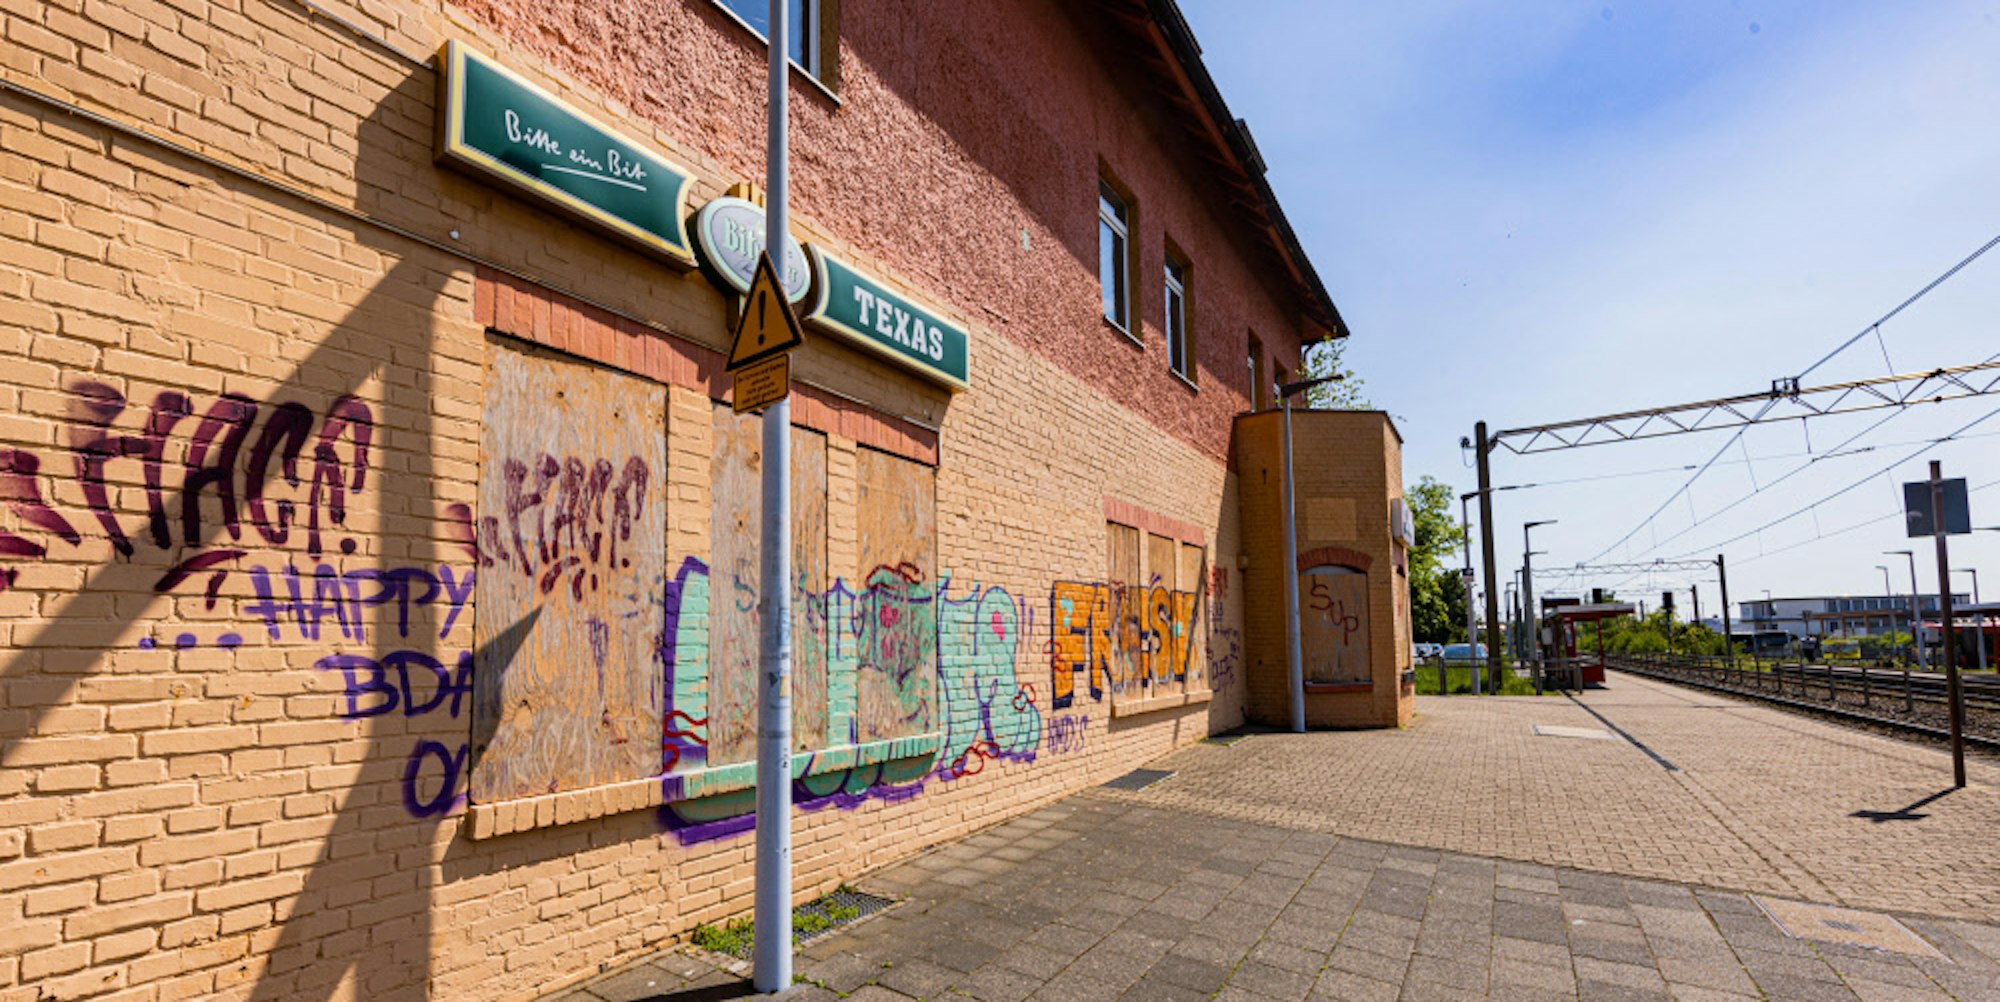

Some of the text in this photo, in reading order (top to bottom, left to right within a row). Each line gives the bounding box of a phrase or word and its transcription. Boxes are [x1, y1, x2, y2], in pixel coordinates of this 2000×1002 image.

[504, 108, 648, 181] Bitte ein Bit
[853, 284, 944, 361] TEXAS
[244, 563, 475, 643] HAPPY
